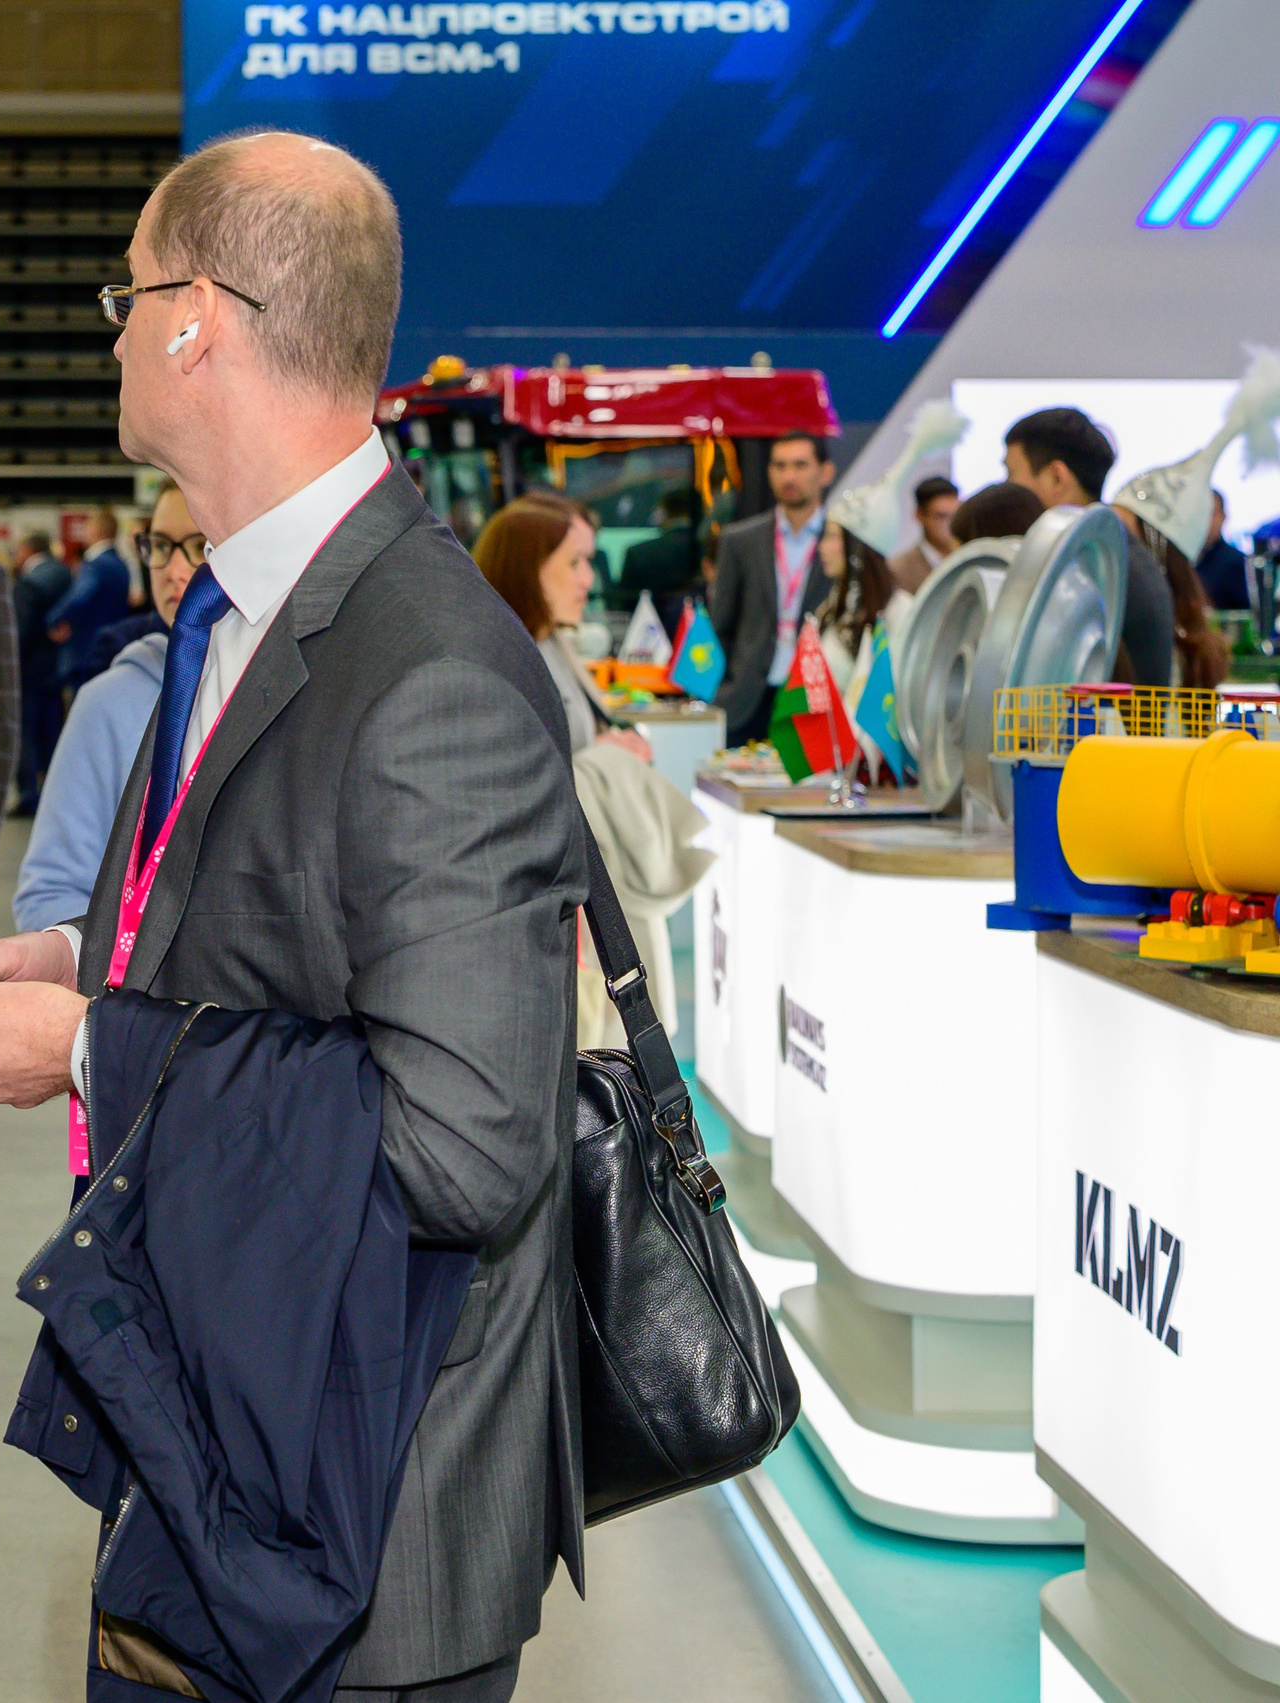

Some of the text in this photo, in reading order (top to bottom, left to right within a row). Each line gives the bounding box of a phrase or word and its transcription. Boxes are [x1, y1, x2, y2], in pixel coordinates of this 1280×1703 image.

[244, 0, 790, 38] ГК НАЦПРОЕКТСТРОЙ
[242, 41, 521, 79] ДЛЯ ВСМ-1
[1075, 1169, 1185, 1357] KLMZ
